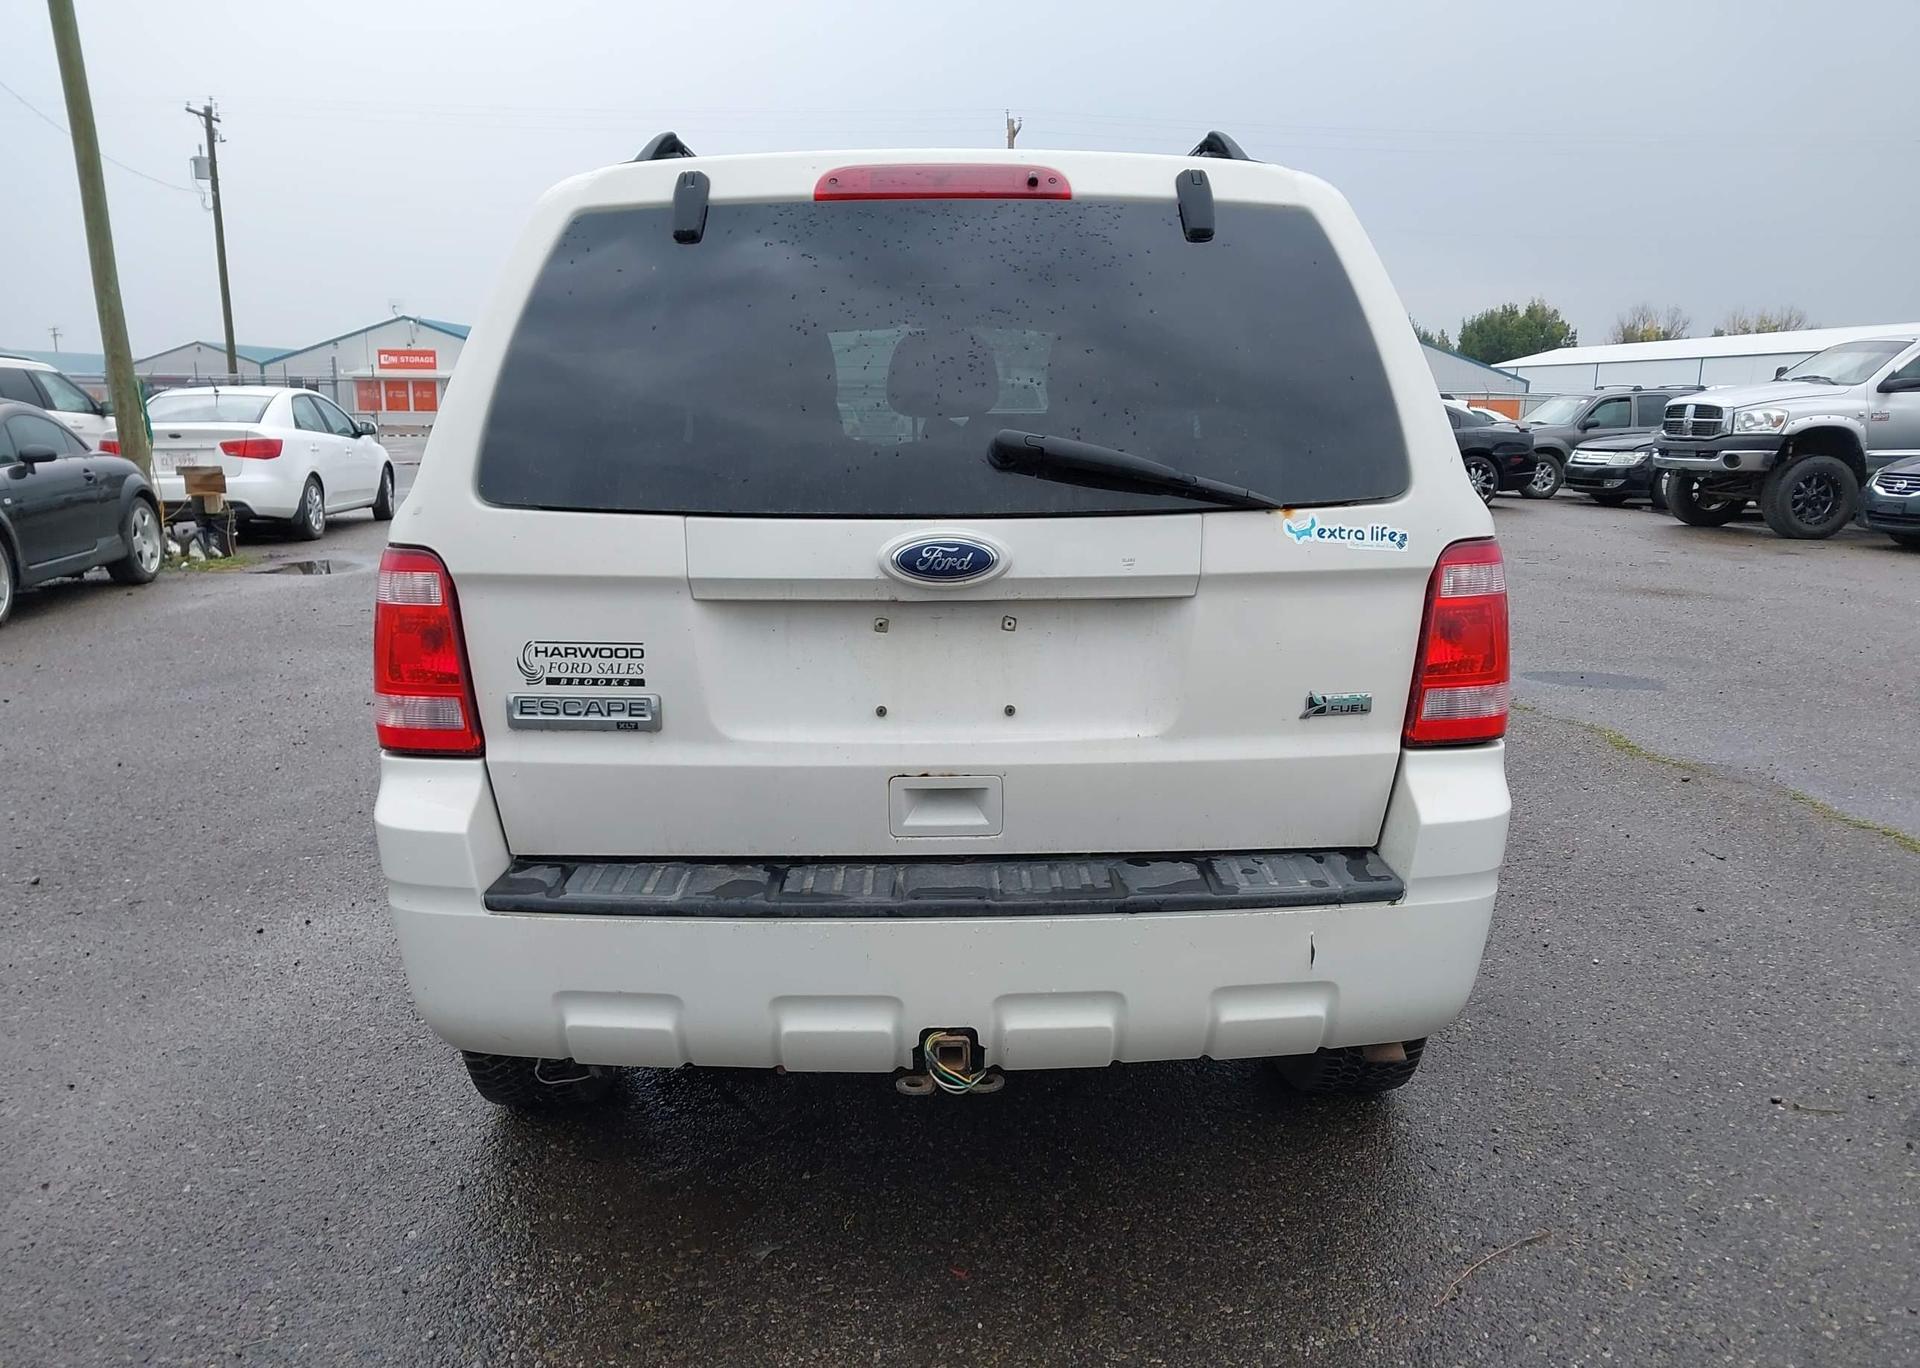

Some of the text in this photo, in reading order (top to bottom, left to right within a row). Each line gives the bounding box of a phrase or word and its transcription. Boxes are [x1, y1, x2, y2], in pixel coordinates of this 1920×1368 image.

[400, 355, 435, 364] STORAGE
[1317, 526, 1365, 540] extra
[1370, 526, 1398, 542] life
[916, 545, 974, 571] Ford
[534, 646, 645, 659] HARWOOD
[547, 662, 645, 675] FORD SALES
[559, 677, 631, 687] BROOKS
[518, 699, 647, 717] ESCAPE
[1330, 704, 1369, 713] FUEL
[618, 722, 637, 730] XLT
